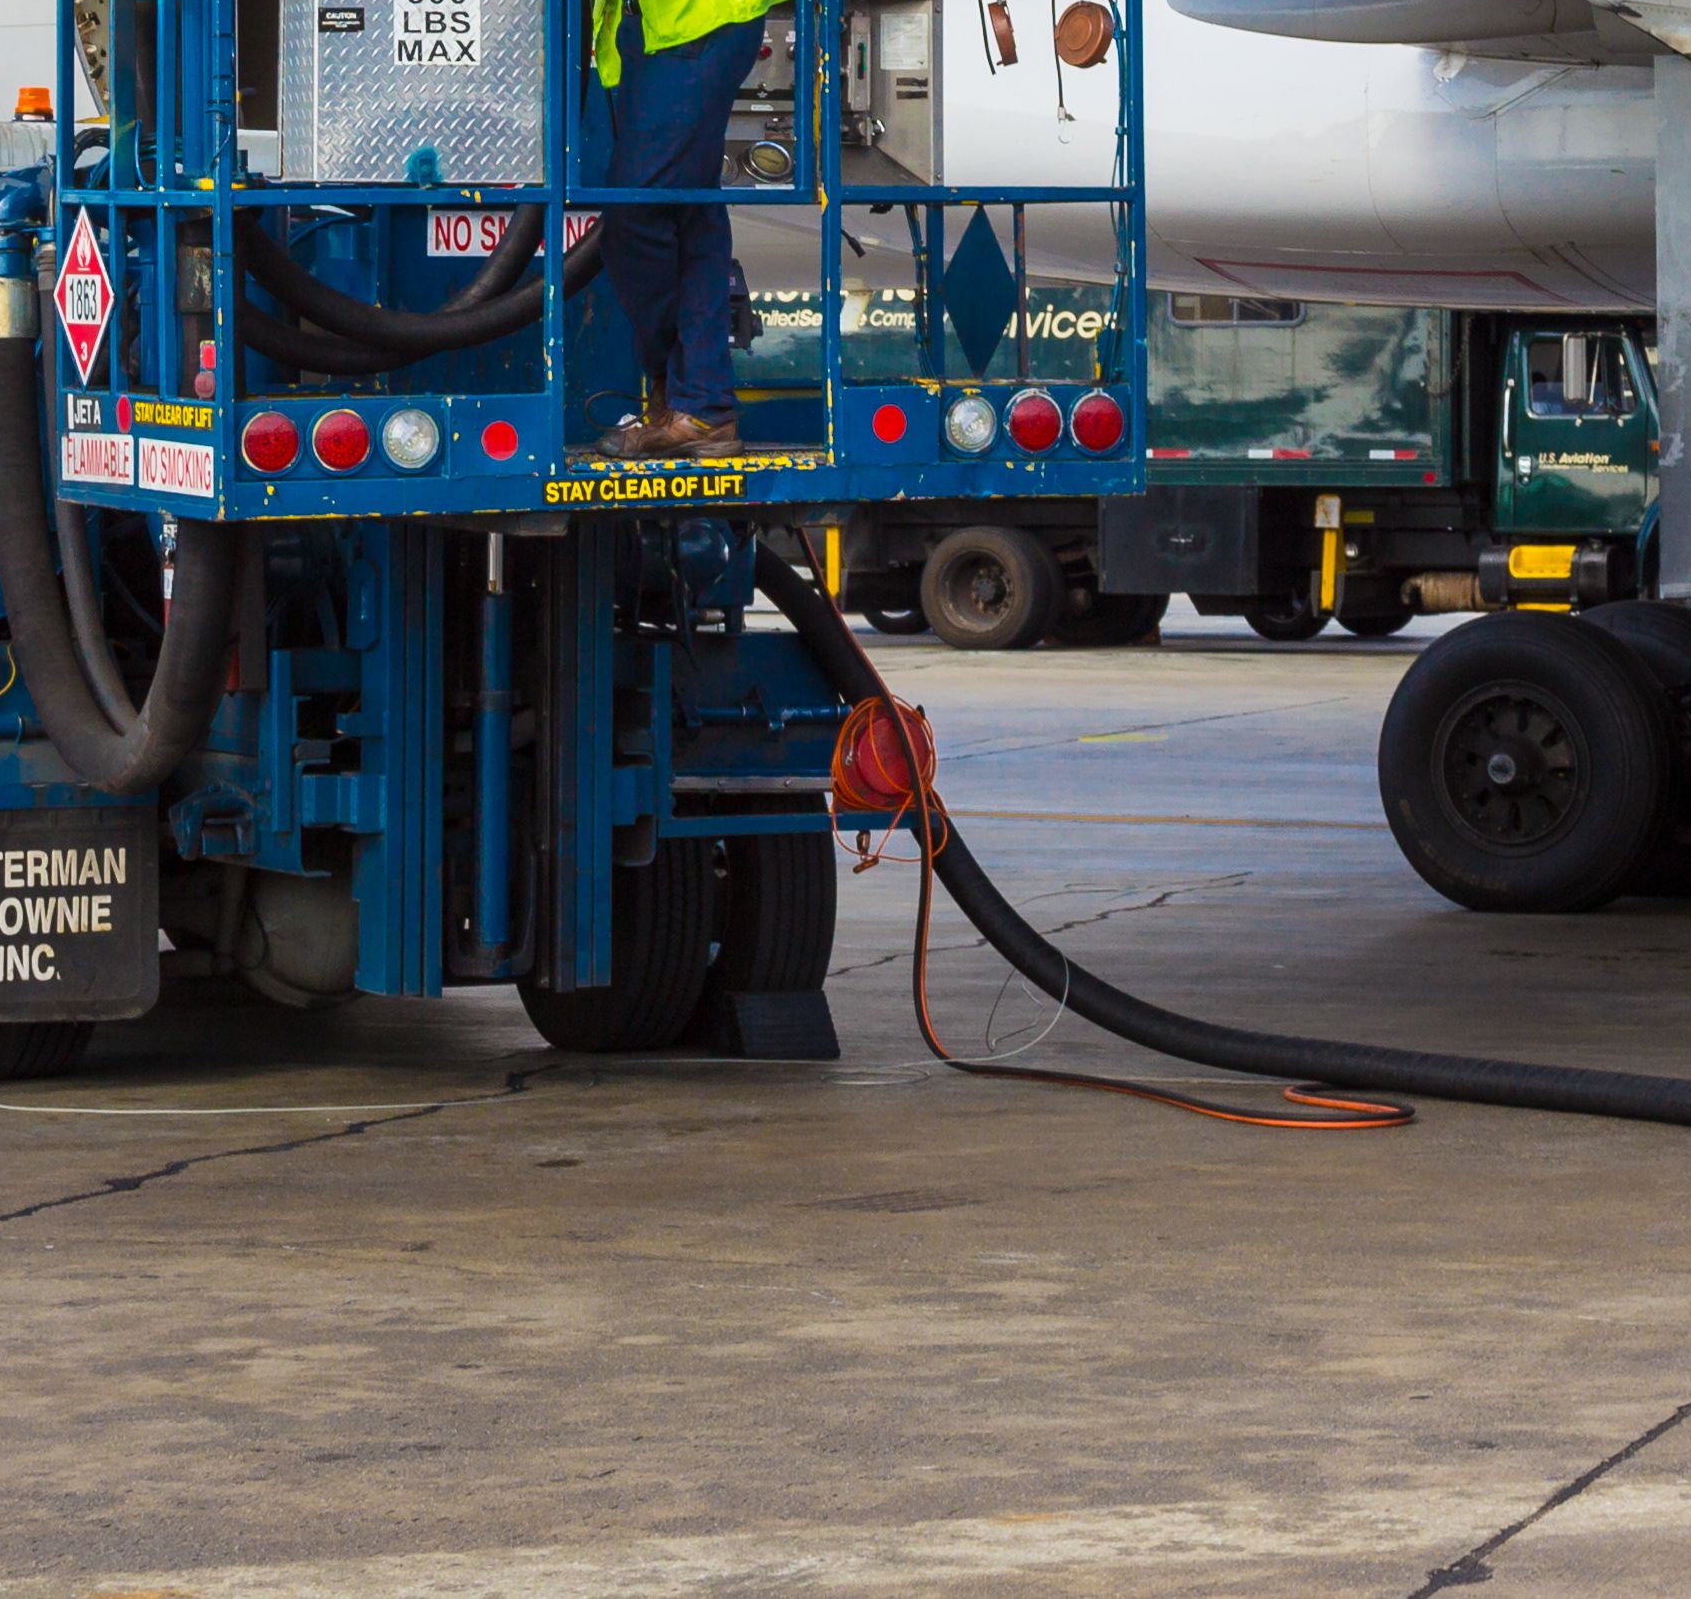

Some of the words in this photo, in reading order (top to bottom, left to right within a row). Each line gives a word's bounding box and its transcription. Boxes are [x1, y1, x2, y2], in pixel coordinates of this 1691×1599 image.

[403, 11, 471, 34] LBS
[397, 40, 477, 62] MAX
[435, 216, 472, 252] NO
[69, 277, 98, 322] 1863
[80, 341, 89, 362] 3
[75, 399, 93, 423] JET
[94, 400, 102, 425] A
[135, 403, 154, 422] STAY
[155, 404, 181, 426] CLEAR
[182, 408, 194, 426] OF
[195, 408, 213, 428] LIFT
[66, 435, 130, 479] FLAMMABLE
[142, 444, 158, 484] NO
[160, 448, 213, 491] SMOKING
[1559, 452, 1609, 464] Aviation
[1592, 464, 1628, 473] Services
[546, 481, 595, 502] STAY
[599, 477, 666, 500] CLEAR
[671, 476, 698, 498] OF
[703, 474, 743, 496] LIFT
